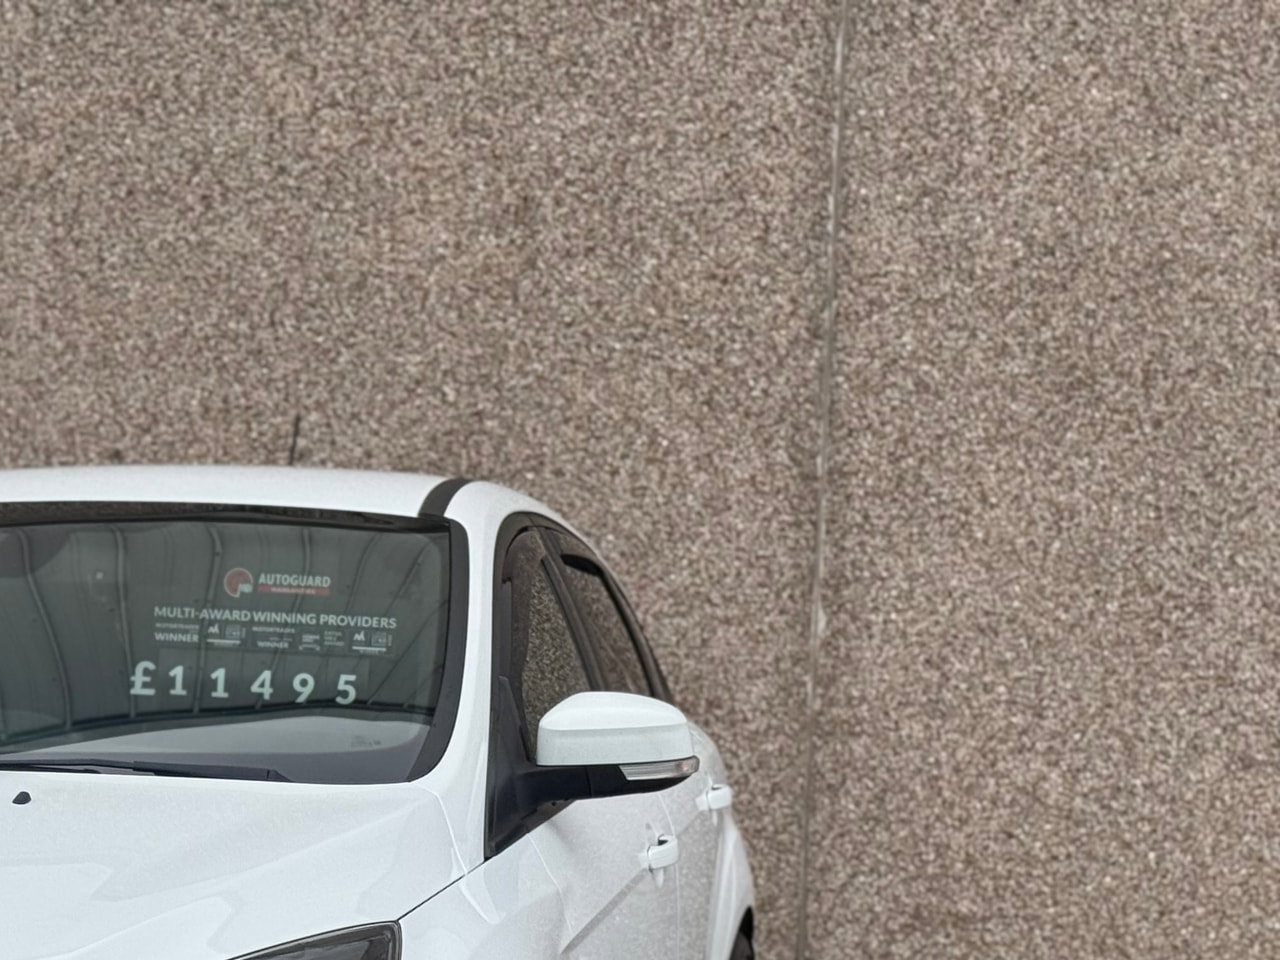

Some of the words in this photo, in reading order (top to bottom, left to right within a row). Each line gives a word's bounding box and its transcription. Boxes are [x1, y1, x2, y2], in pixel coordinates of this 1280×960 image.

[258, 573, 332, 588] AUTOGUARD
[153, 606, 251, 621] MULTI-AWARD
[252, 610, 317, 625] WINNING
[319, 614, 397, 629] PROVIDERS
[154, 631, 200, 643] WINNER
